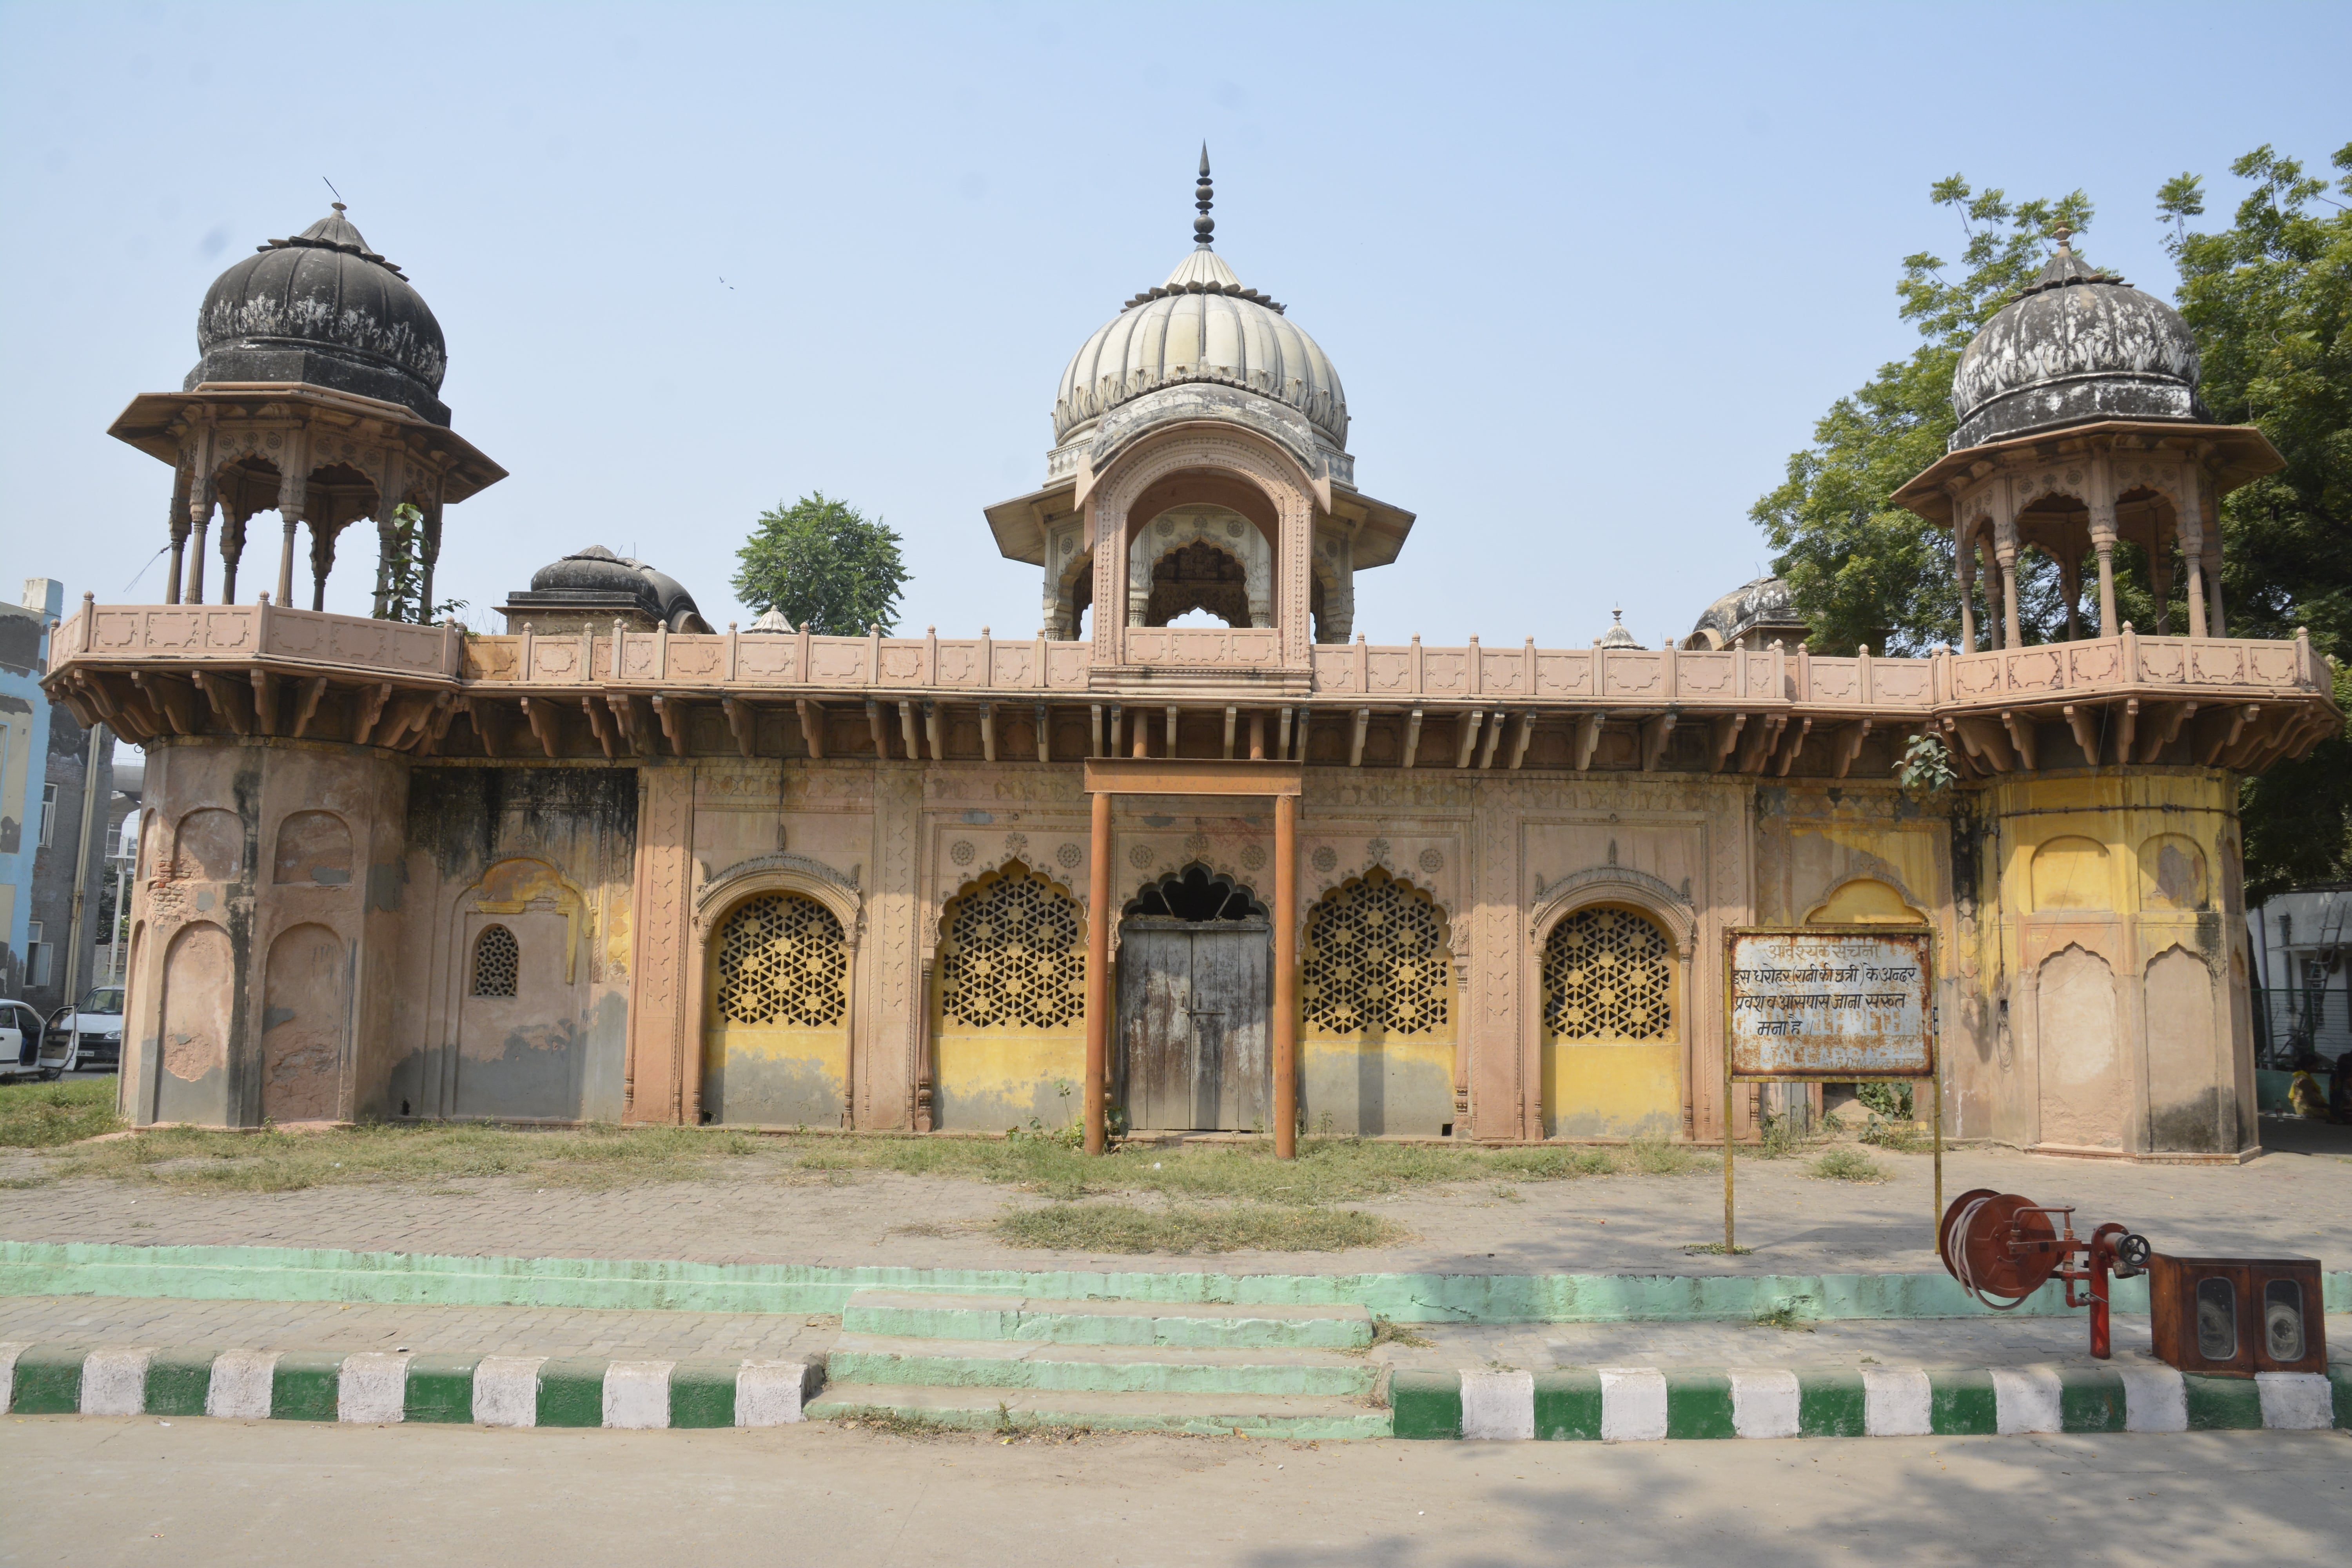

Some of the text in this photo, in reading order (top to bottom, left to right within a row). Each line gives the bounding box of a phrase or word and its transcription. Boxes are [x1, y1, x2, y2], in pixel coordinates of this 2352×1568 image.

[1764, 945, 1880, 961] आवश्यक सूचना
[1733, 970, 1751, 988] इस
[1752, 963, 1792, 987] धरोहर
[1879, 967, 1917, 986] अन्दर
[1735, 990, 1766, 1012] प्रवेश
[1767, 996, 1777, 1010] व
[1777, 994, 1832, 1010] आसपास
[1831, 994, 1864, 1010] जाना
[1757, 1021, 1789, 1036] मना
[1788, 1013, 1803, 1041] है
